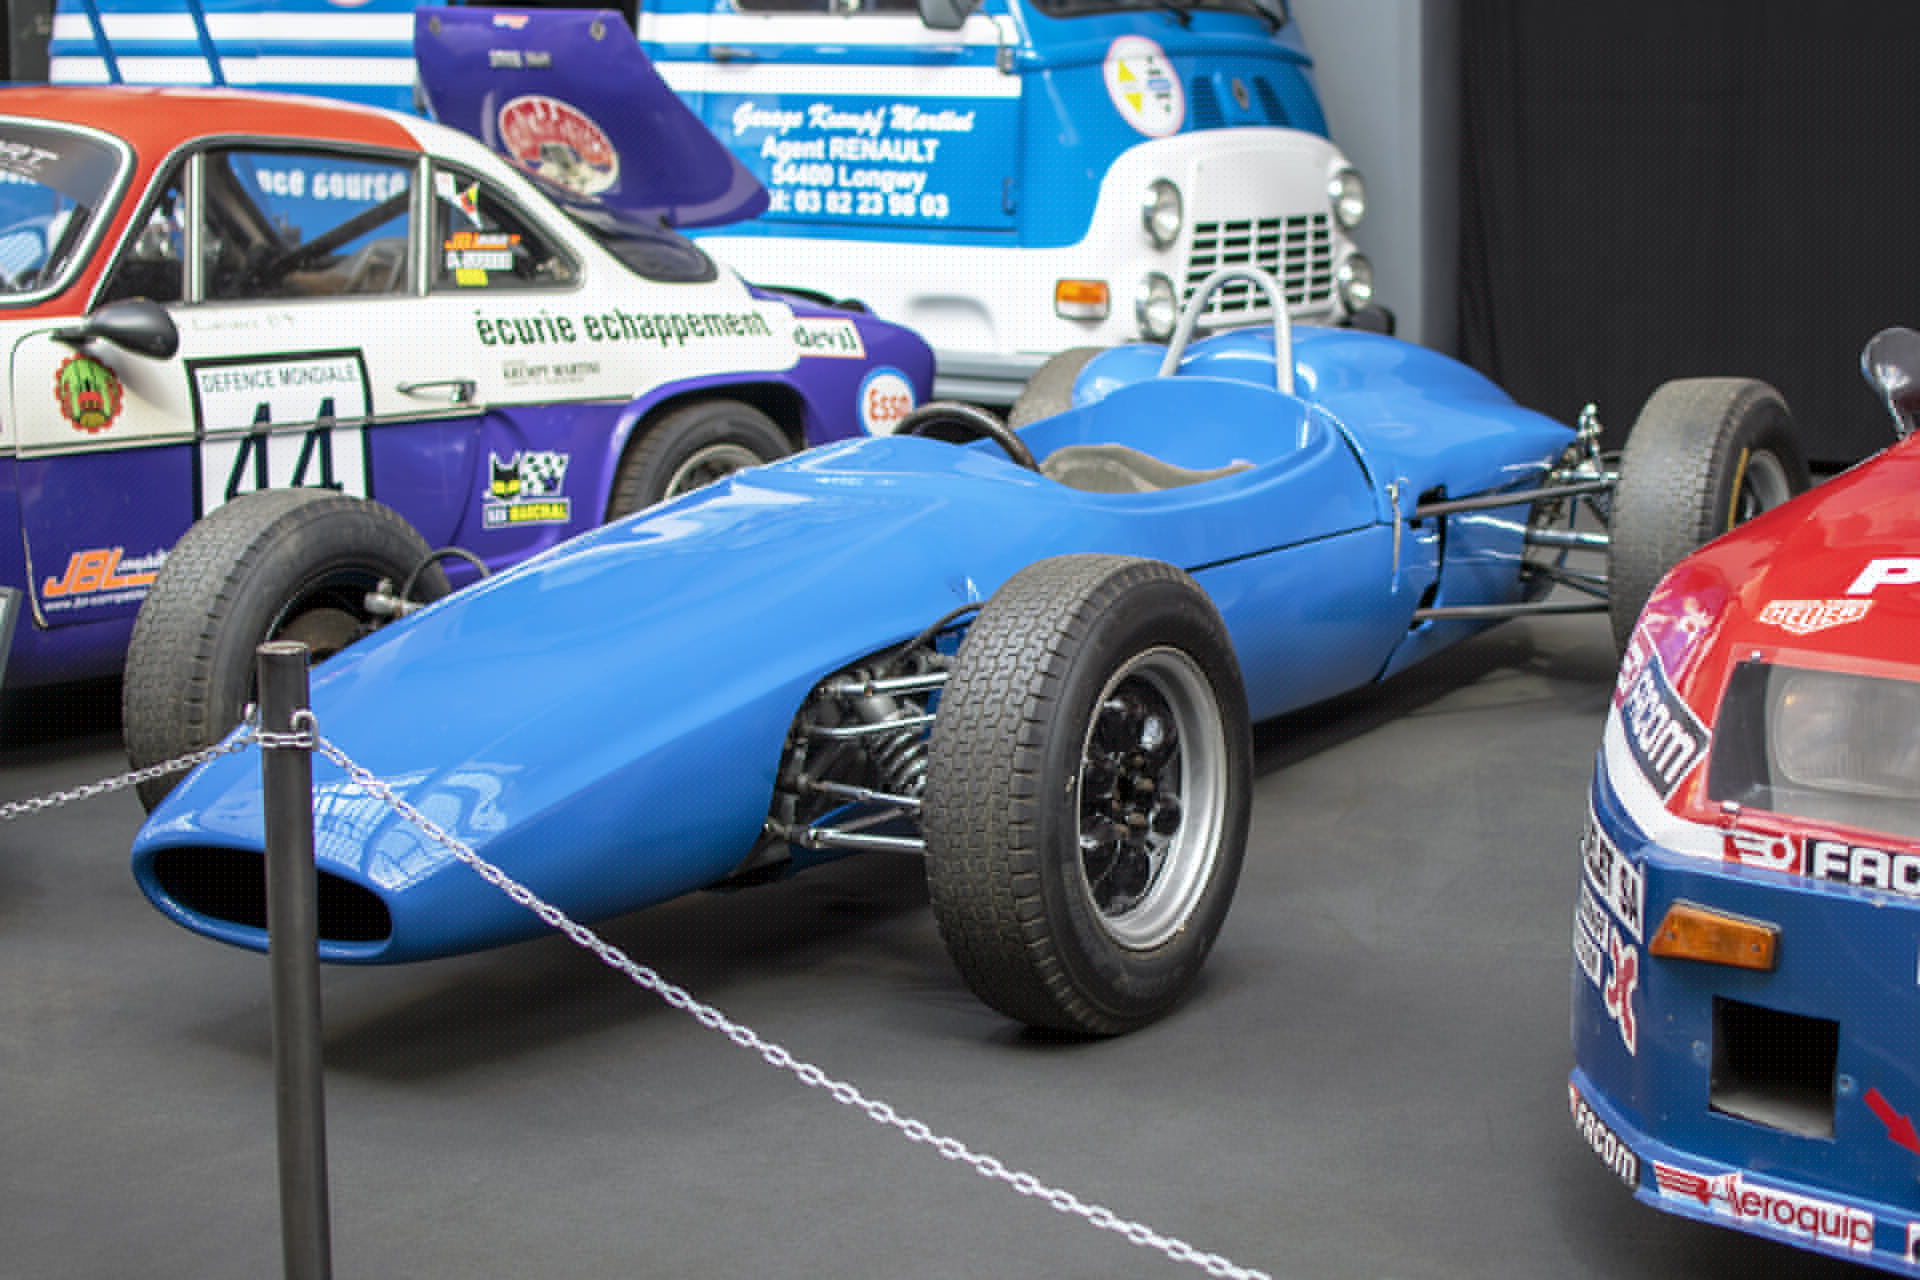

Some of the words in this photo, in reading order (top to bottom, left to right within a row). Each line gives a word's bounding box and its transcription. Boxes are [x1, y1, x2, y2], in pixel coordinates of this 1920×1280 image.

[760, 135, 825, 164] Agent
[829, 137, 940, 162] RENAULT
[838, 165, 928, 193] Longwy
[474, 308, 576, 346] écurie
[582, 306, 772, 348] echappement
[793, 325, 857, 350] devil
[202, 368, 276, 392] DEFENCE
[279, 363, 358, 385] MONDIALE
[869, 388, 909, 421] Esso
[225, 397, 343, 503] 44
[43, 548, 122, 596] JBL
[1815, 842, 1920, 893] FAC
[1709, 1174, 1873, 1249] Aeroquip
